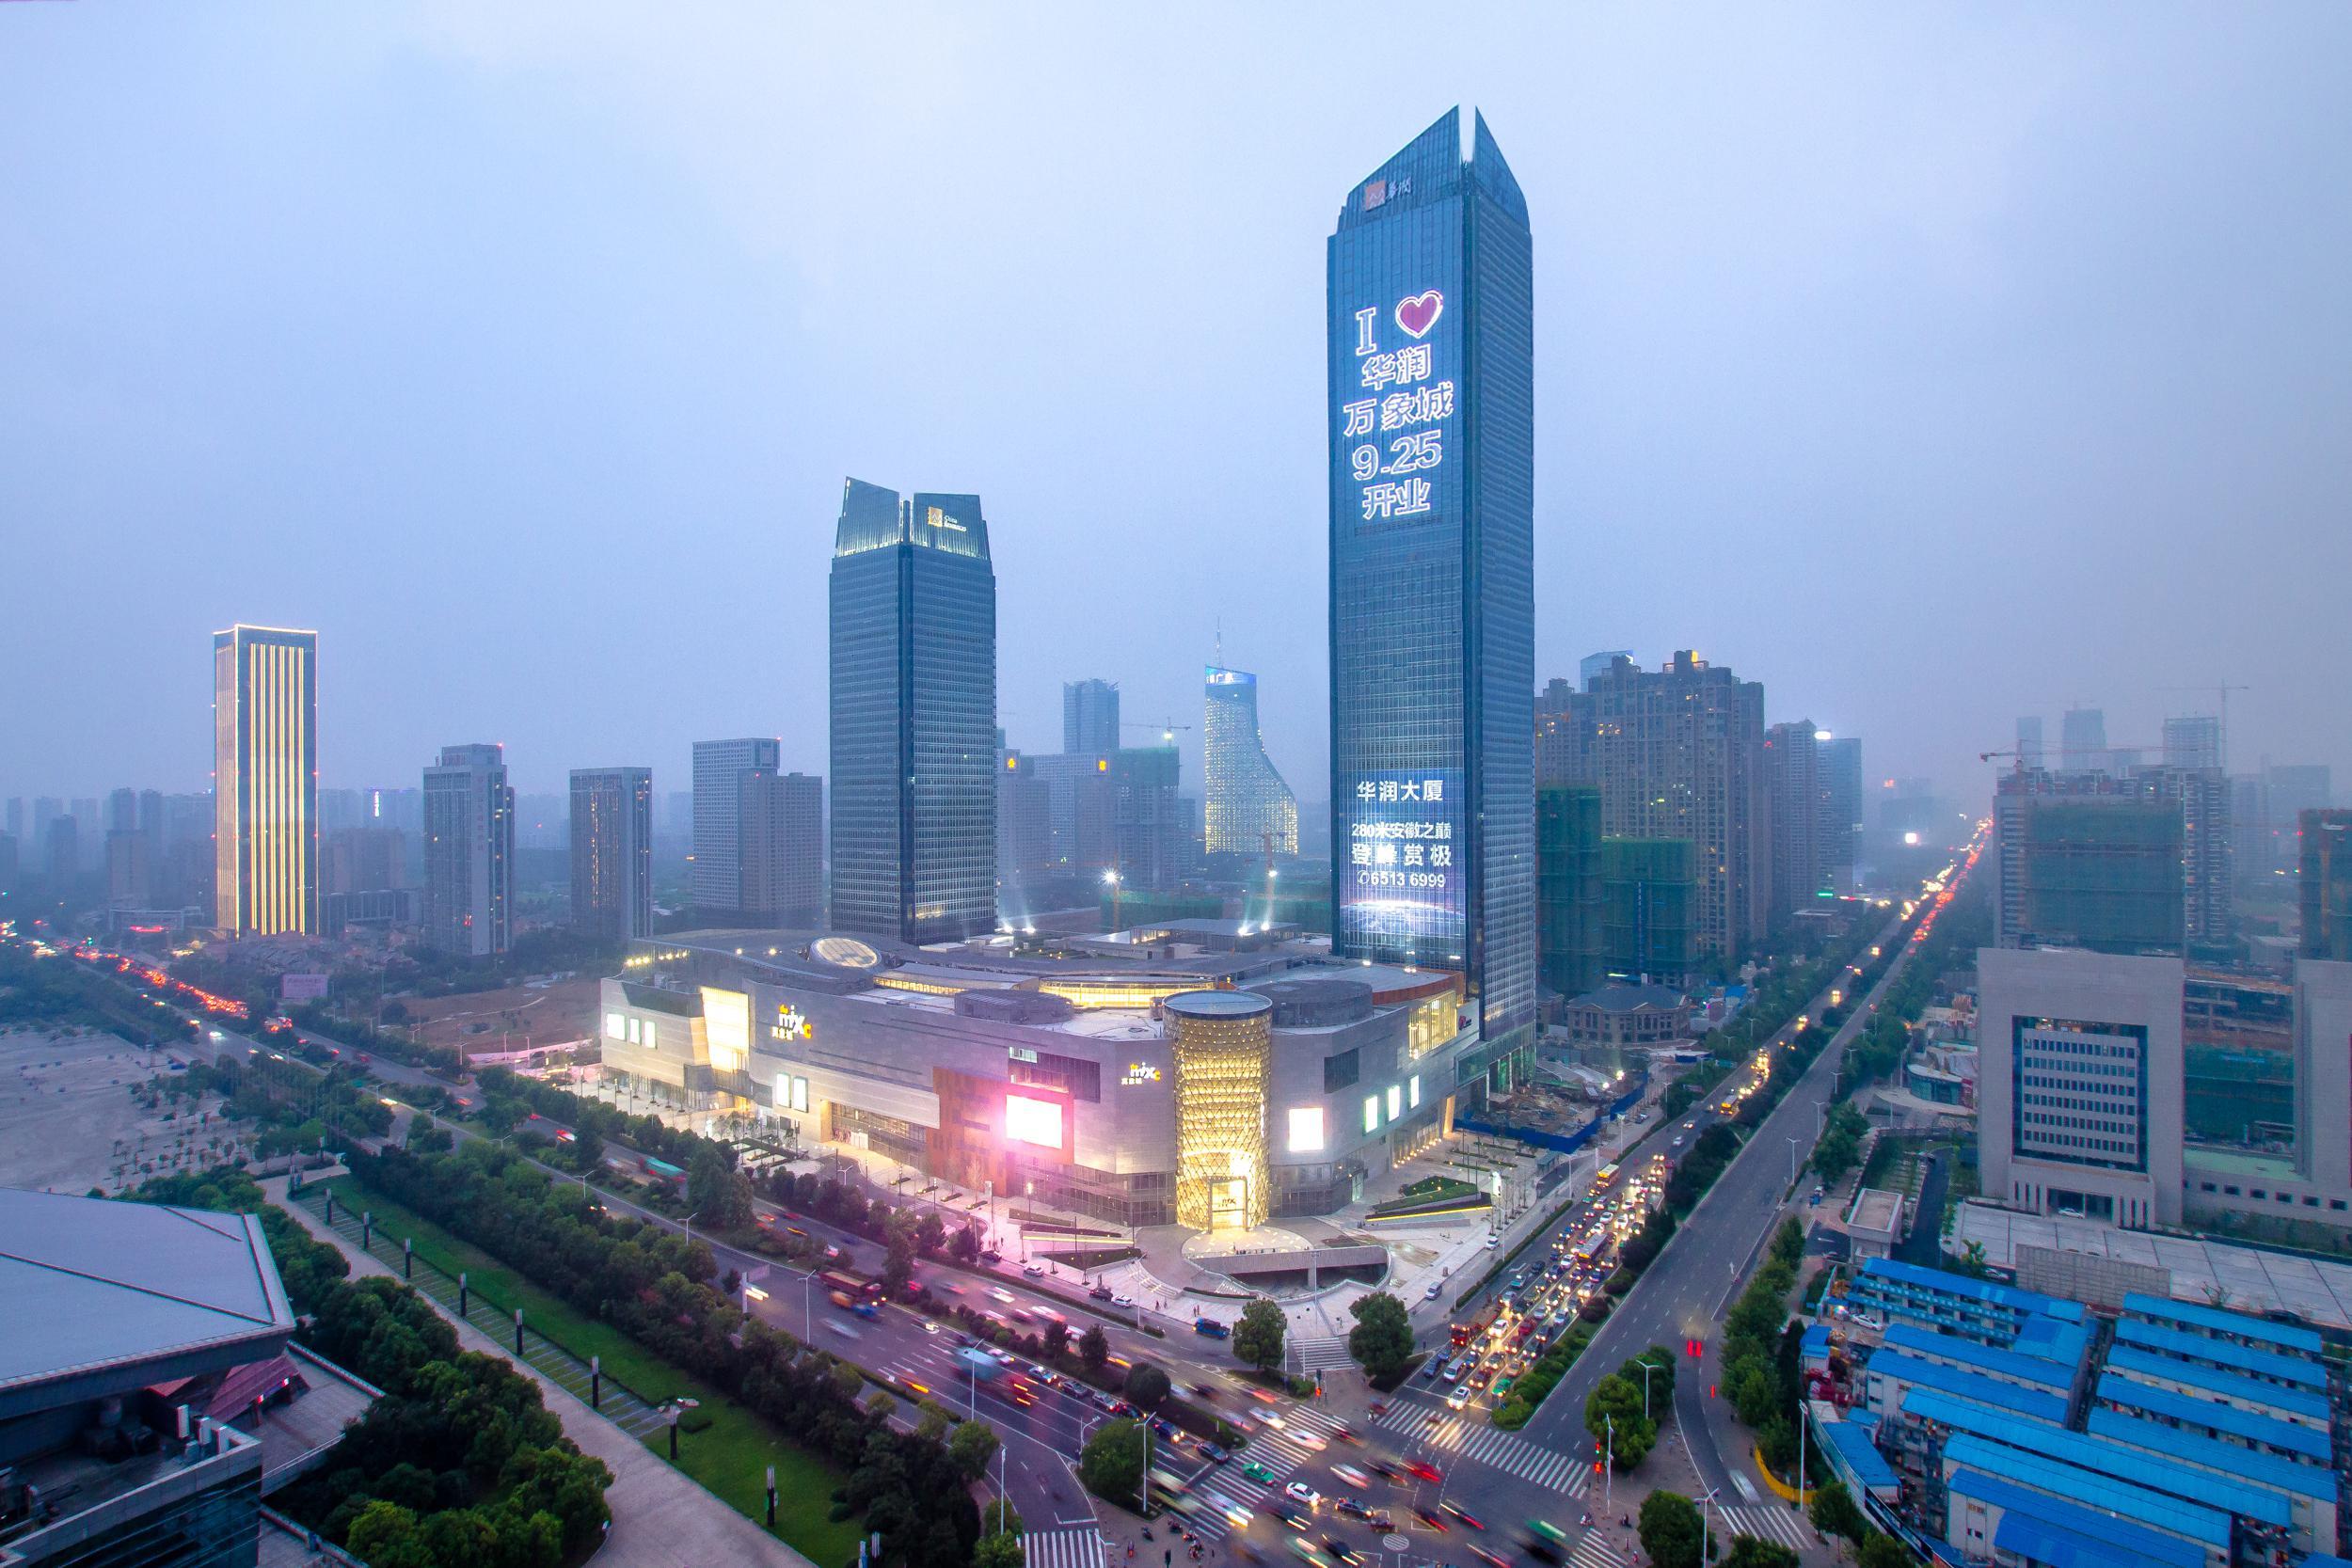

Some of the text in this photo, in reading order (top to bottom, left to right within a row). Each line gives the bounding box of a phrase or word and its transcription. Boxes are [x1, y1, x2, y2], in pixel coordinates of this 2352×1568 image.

[1356, 307, 1376, 356] I
[1361, 343, 1431, 391] 华润
[1343, 381, 1454, 437] 万象城
[1352, 429, 1443, 481] 9.25
[1361, 477, 1431, 519] 开业
[1357, 780, 1444, 801] 华润大厦
[1351, 821, 1452, 839] 280米安徽之巅
[1371, 872, 1446, 888] 6513 6999
